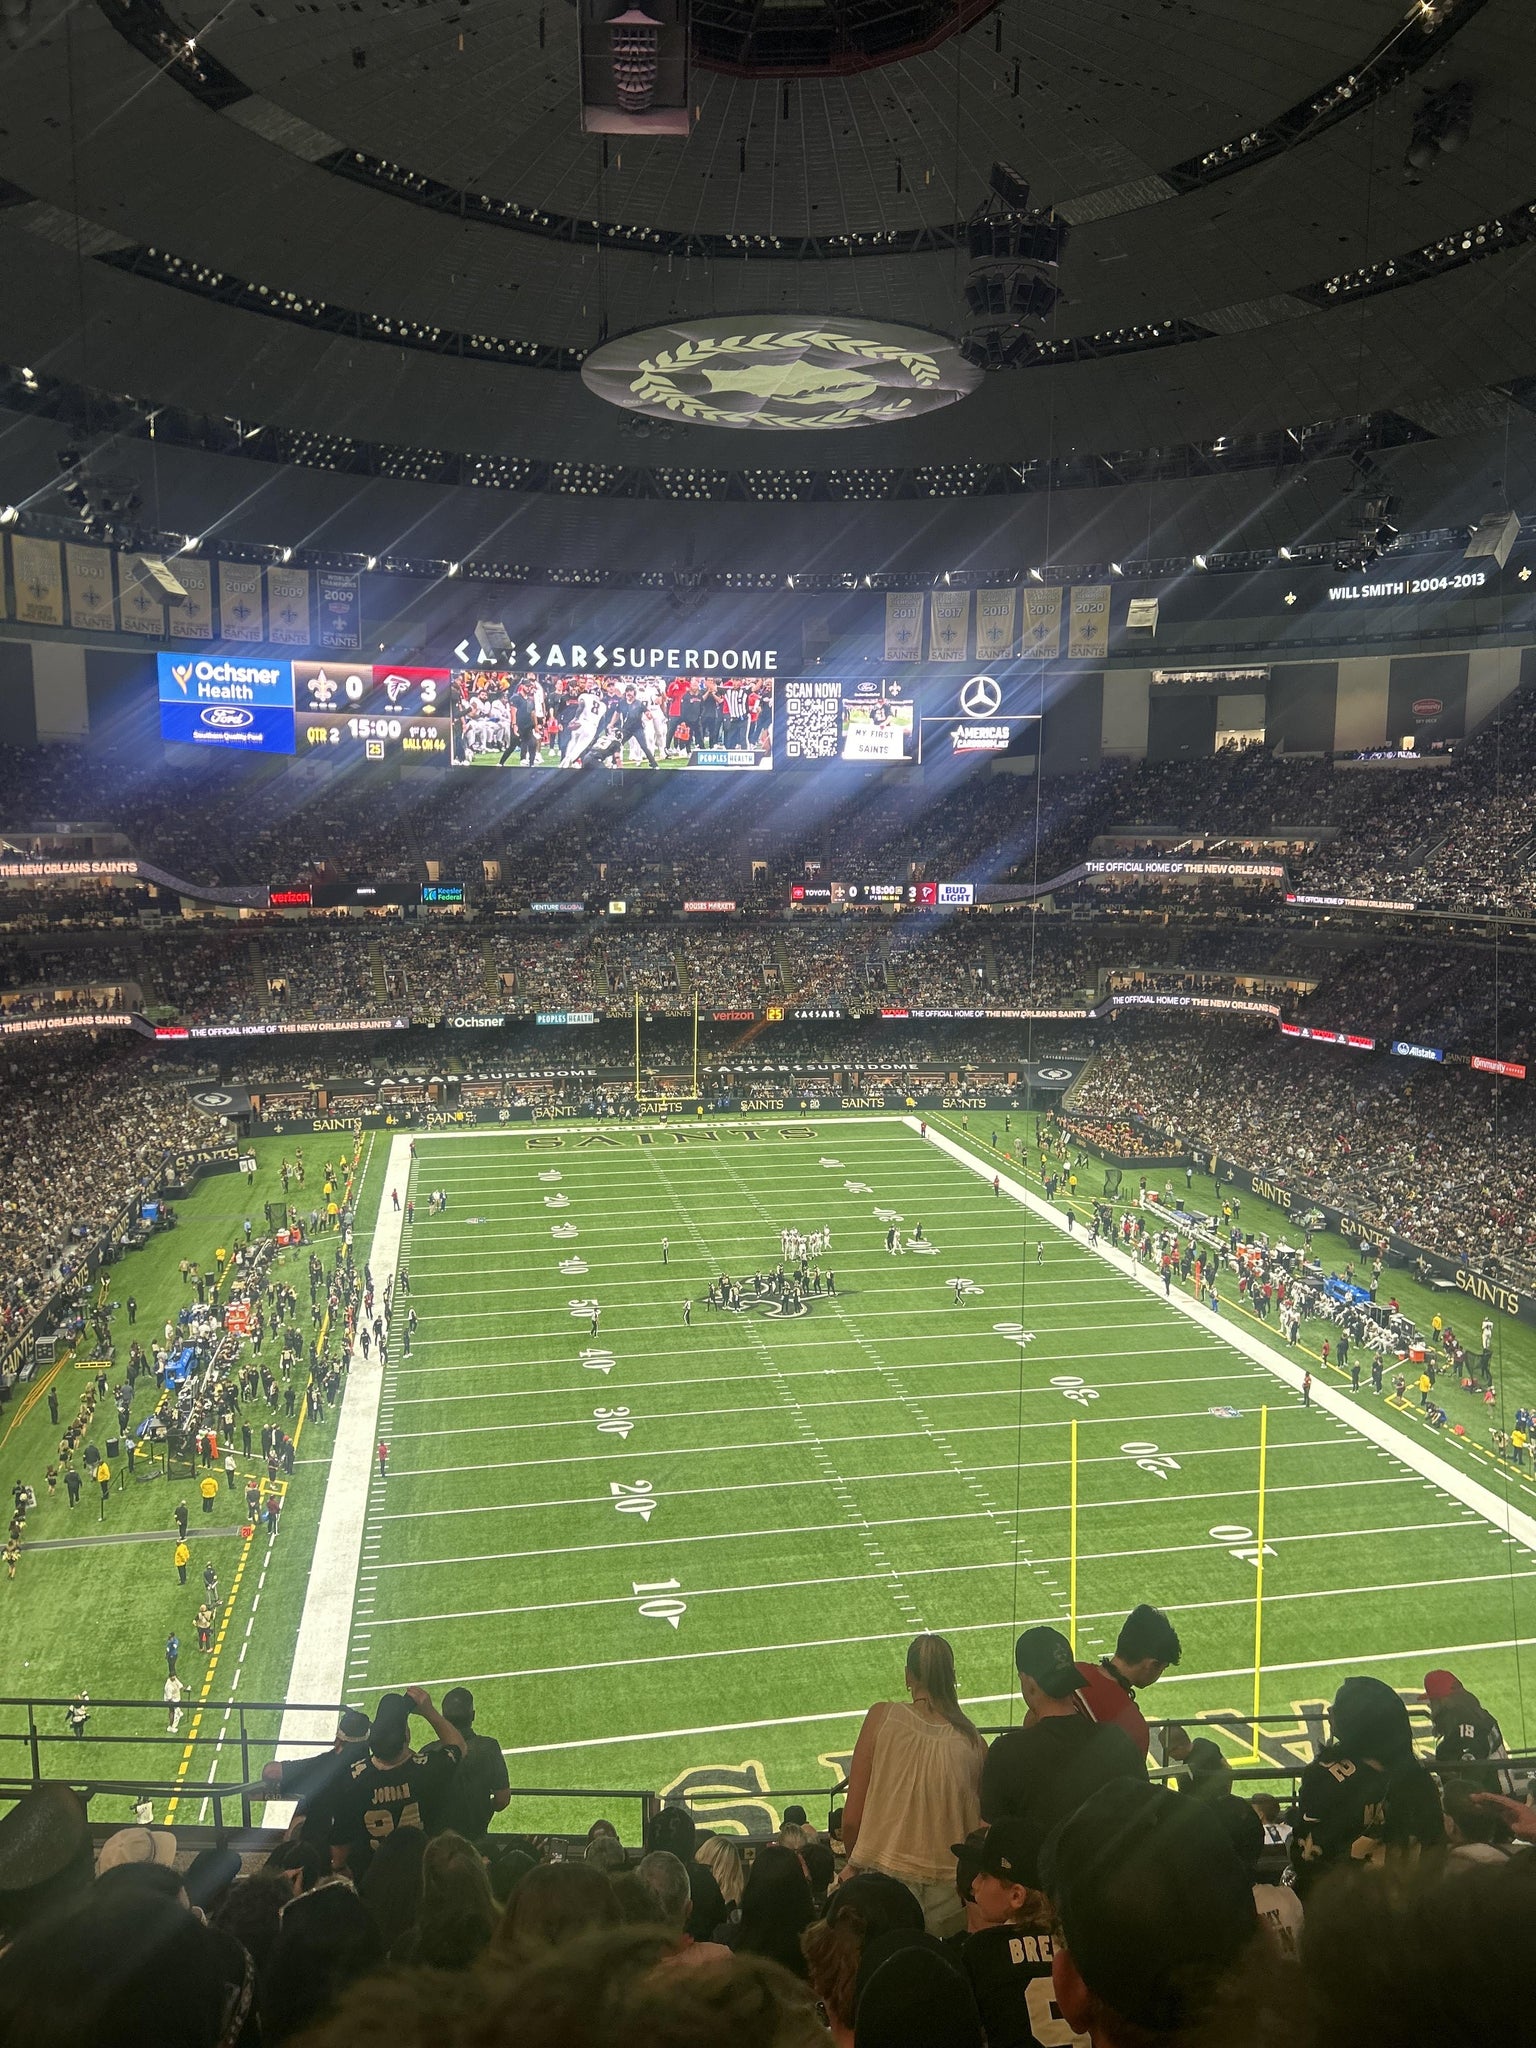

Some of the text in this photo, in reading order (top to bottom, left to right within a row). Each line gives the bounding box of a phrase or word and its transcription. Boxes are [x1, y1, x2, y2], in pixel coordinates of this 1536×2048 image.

[226, 581, 256, 593] 2009
[273, 585, 303, 598] 2009
[1329, 572, 1486, 600] WILL SMITH 2004-2013
[324, 590, 353, 602] 2009
[893, 607, 916, 618] 2011
[937, 607, 963, 618] 2017
[983, 606, 1009, 616] 2018
[1029, 604, 1055, 615] 2019
[1075, 602, 1104, 613] 2020
[124, 620, 162, 633] SAINTS
[173, 625, 210, 637] SAINTS
[322, 637, 358, 648] SAINTS
[613, 646, 778, 670] SUPERDOME
[886, 651, 919, 660] SAINTS
[931, 651, 964, 660] SAINTS
[978, 649, 1010, 658] SAINTS
[1070, 648, 1105, 657] SAINTS
[194, 661, 280, 685] Ochsner
[197, 684, 254, 700] Health
[345, 675, 363, 700] 0
[420, 679, 437, 702] 3
[785, 682, 842, 699] SCAN NOW!
[210, 708, 244, 724] Ford
[347, 718, 401, 738] 15:00
[855, 728, 894, 739] MY FIRST
[307, 726, 340, 745] QTR 2
[369, 743, 382, 755] 25
[858, 744, 889, 754] SAINTS
[699, 753, 754, 763] PEOPLES HEALTH
[0, 861, 138, 876] THE NEW ORLEANS SAINTS
[1086, 862, 1271, 876] THE OFFICIAL HOME OF THE NEW ORLEANS
[805, 889, 831, 897] TOYOTA
[848, 886, 858, 897] 0
[870, 885, 894, 895] 15:00
[908, 886, 917, 898] 3
[945, 886, 967, 895] BUD
[270, 892, 310, 903] verizon
[437, 893, 462, 901] Federal
[941, 894, 971, 902] LIGHT
[1305, 896, 1324, 904] OFFICIAL
[1323, 897, 1337, 905] HOME
[1345, 898, 1355, 906] THE
[1368, 900, 1394, 909] ORLEANS
[1394, 902, 1415, 910] SAINTS
[530, 903, 584, 911] VENTURE GLOBAL
[684, 902, 735, 910] ROUSES MARKETS
[1448, 905, 1474, 914] SAINTS
[1505, 909, 1532, 919] SAINTS
[1112, 995, 1270, 1013] THE OFFICIAL HOME OF THE NEW ORLEANS
[412, 1015, 441, 1025] SAINTS
[537, 1014, 593, 1024] PEOPLES HEALTH
[605, 1011, 632, 1019] SAINTS
[665, 1010, 692, 1018] SAINTS
[712, 1011, 755, 1021] verizon
[768, 1009, 782, 1019] 25
[794, 1010, 841, 1018] CAESARS
[985, 1010, 1001, 1018] THE
[1001, 1010, 1020, 1018] NEW
[1020, 1009, 1057, 1019] ORLEANS
[1058, 1010, 1087, 1018] SAINTS
[3, 1015, 132, 1033] THE NEW ORLEANS SAINTS
[454, 1016, 504, 1028] Ochsner
[191, 1028, 207, 1037] THE
[207, 1027, 242, 1036] OFFICIAL
[242, 1025, 266, 1034] HOME
[266, 1025, 277, 1033] OF
[278, 1024, 297, 1033] THE
[297, 1024, 320, 1032] NEW
[319, 1021, 360, 1031] ORLEANS
[359, 1020, 392, 1029] SAINTS
[1408, 1046, 1437, 1060] Allstate
[702, 1063, 919, 1072] CAESARS SUPERDOME
[1474, 1057, 1506, 1074] Community
[364, 1069, 599, 1086] CAESARS SUPERDOME
[740, 1099, 784, 1110] SAINTS
[809, 1098, 820, 1110] 20
[841, 1097, 885, 1109] SAINTS
[312, 1117, 362, 1132] SAINTS
[525, 1127, 818, 1151] SAINTS
[1251, 1178, 1291, 1208] SAINTS
[1455, 1268, 1519, 1315] SAINTS
[568, 1299, 602, 1317] 50
[992, 1323, 1037, 1343] 40
[579, 1348, 617, 1369] 40
[1050, 1375, 1100, 1399] 30
[593, 1406, 635, 1434] 30
[1120, 1441, 1182, 1472] 20
[609, 1480, 658, 1514] 20
[1208, 1524, 1279, 1562] 10
[632, 1578, 688, 1618] 10
[1458, 1724, 1475, 1738] 18
